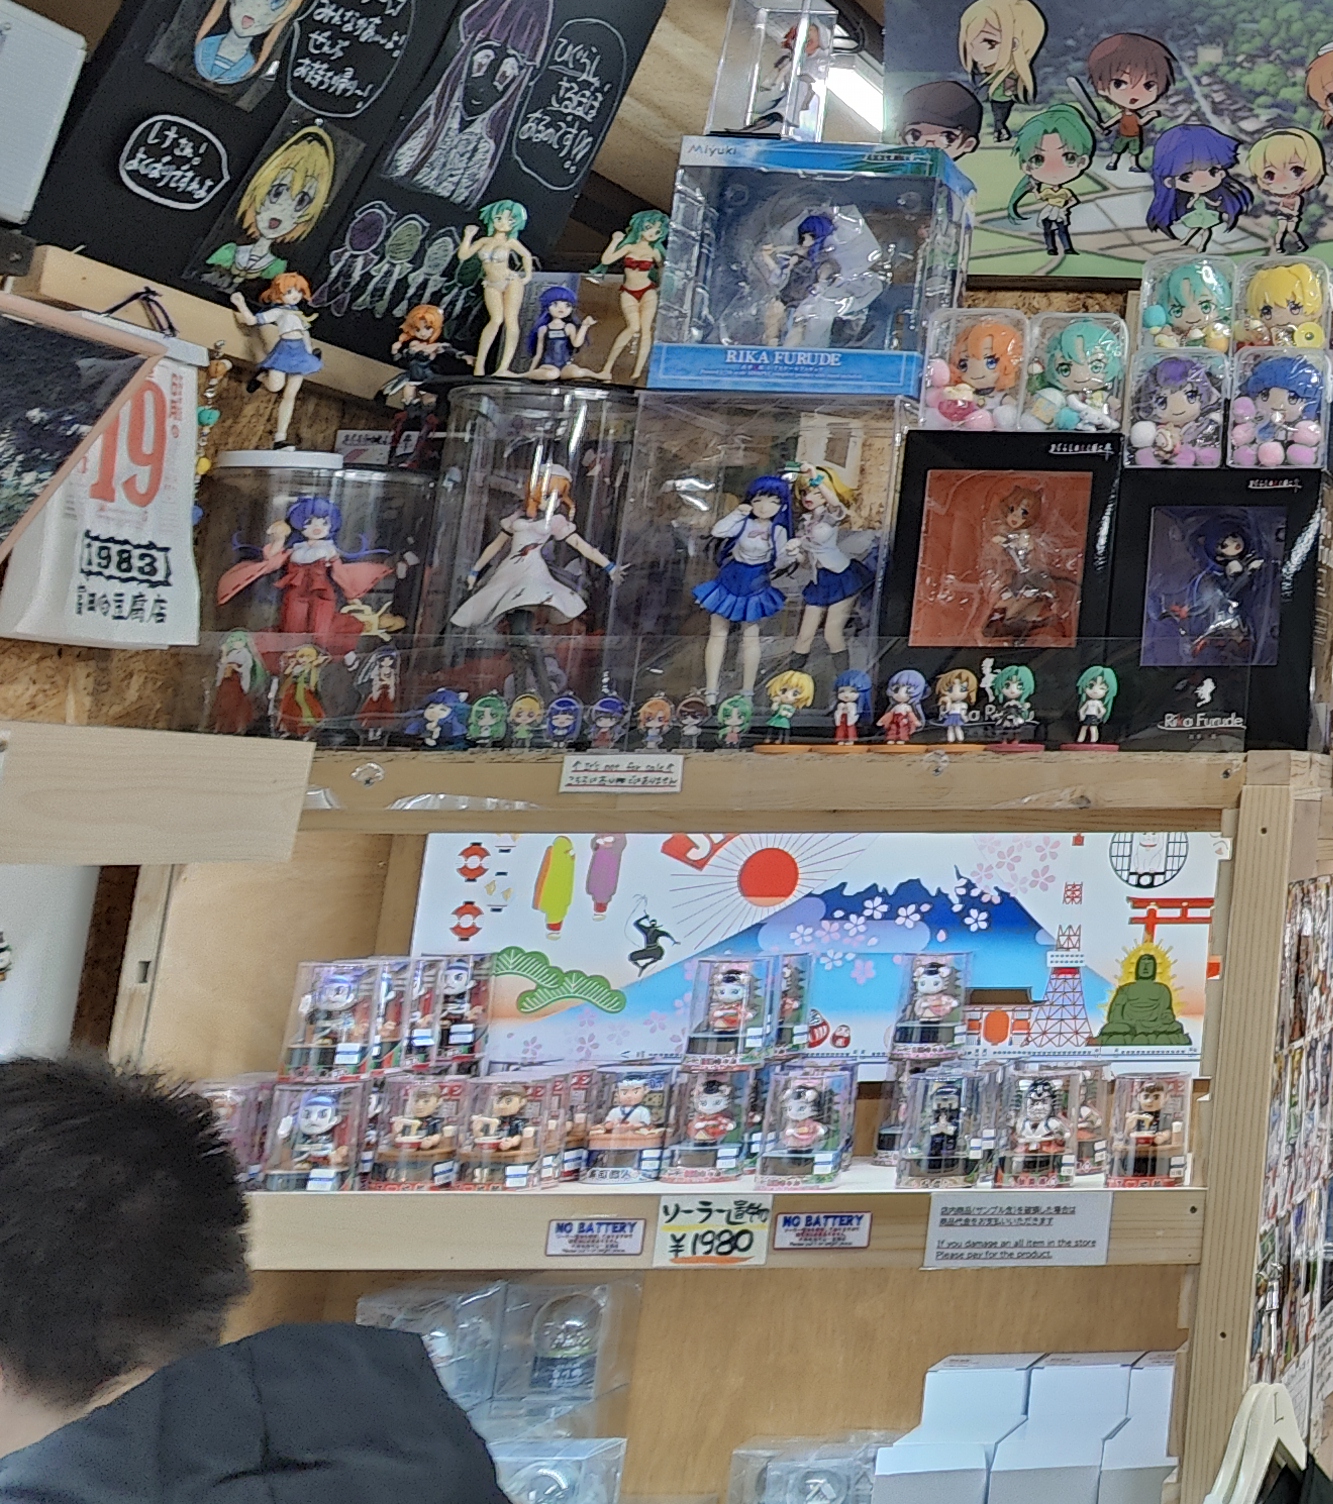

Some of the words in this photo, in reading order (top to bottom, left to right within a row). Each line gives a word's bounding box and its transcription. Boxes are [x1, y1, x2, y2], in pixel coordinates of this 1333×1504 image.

[725, 349, 771, 363] RIKA
[773, 350, 842, 367] FURUDE
[84, 542, 158, 578] 1983
[1164, 712, 1194, 728] Rika
[1195, 713, 1244, 728] Furude
[555, 1222, 573, 1235] NO
[577, 1221, 639, 1235] BATTERY
[782, 1215, 802, 1228] NO
[807, 1214, 865, 1228] BATTERY
[668, 1229, 756, 1258] ¥1980
[964, 1240, 999, 1249] damage
[935, 1250, 965, 1259] Please
